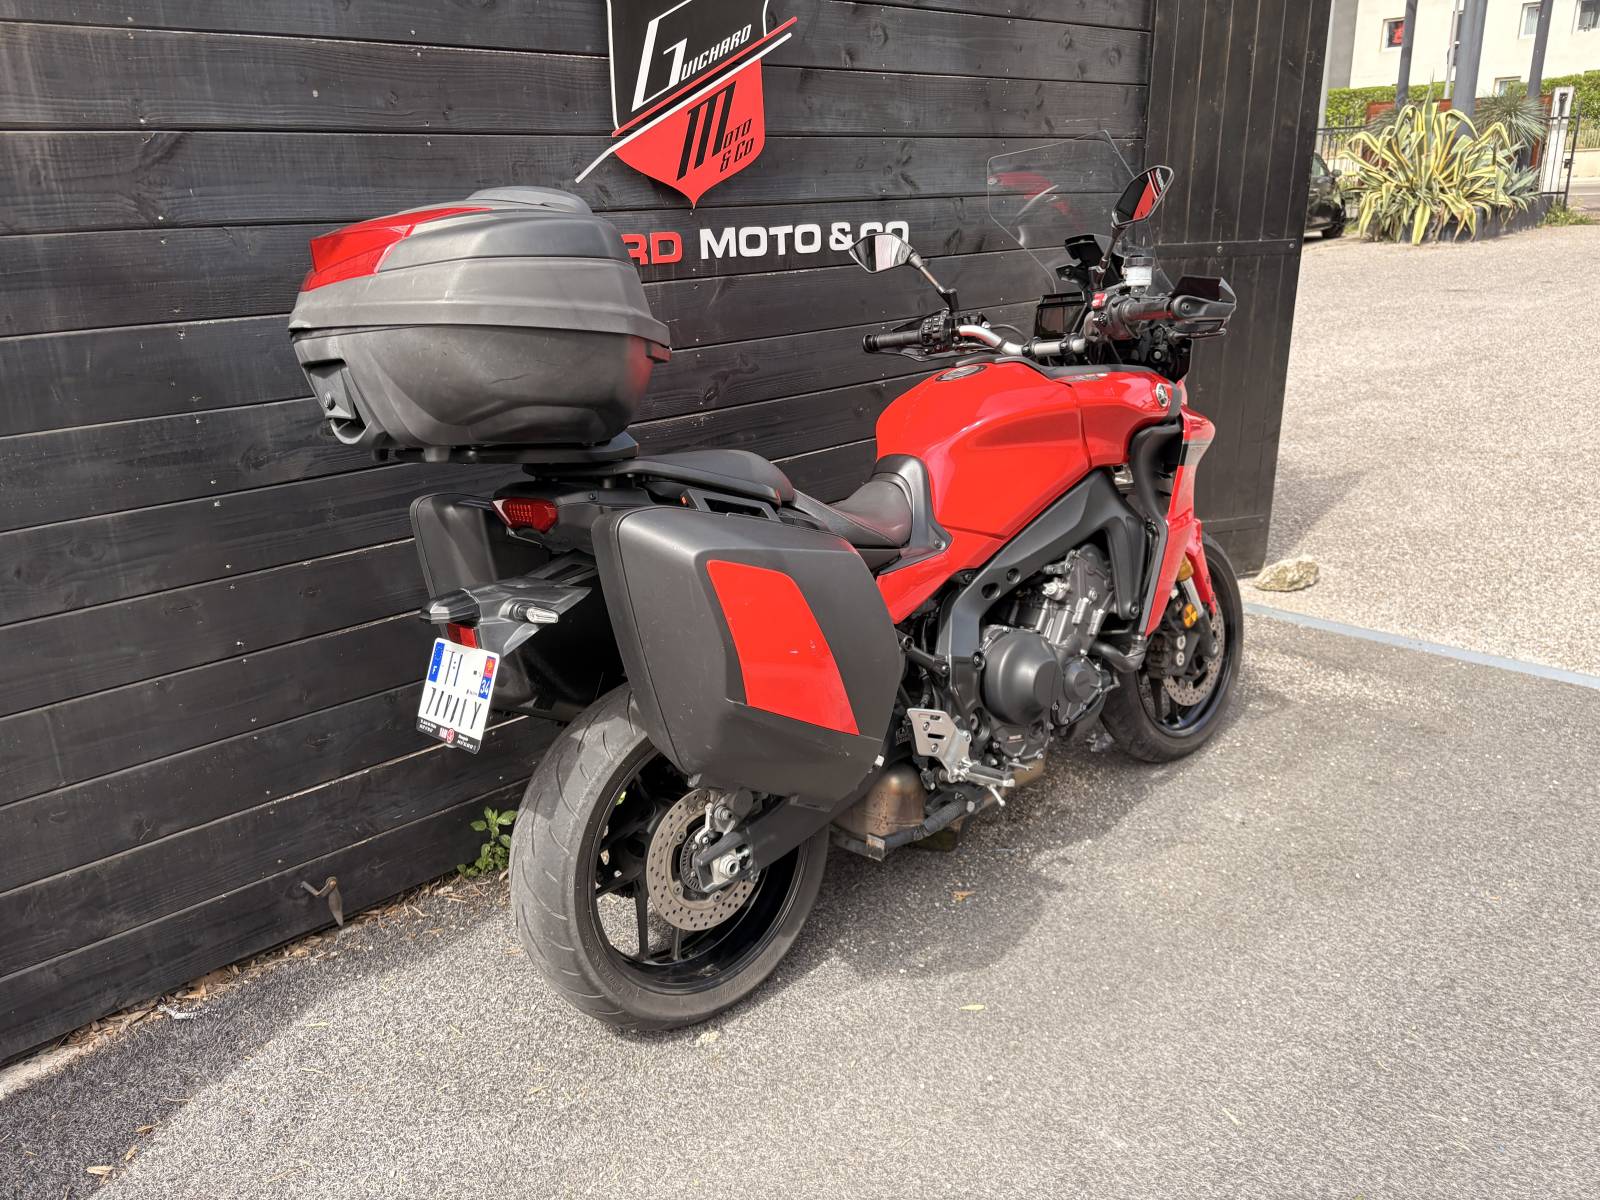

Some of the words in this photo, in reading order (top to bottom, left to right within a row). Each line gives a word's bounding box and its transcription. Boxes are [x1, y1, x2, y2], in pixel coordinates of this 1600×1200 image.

[631, 0, 752, 112] GUICHARD
[676, 80, 752, 181] MOTO
[720, 149, 731, 173] &
[621, 231, 683, 265] RD
[480, 679, 490, 697] 34
